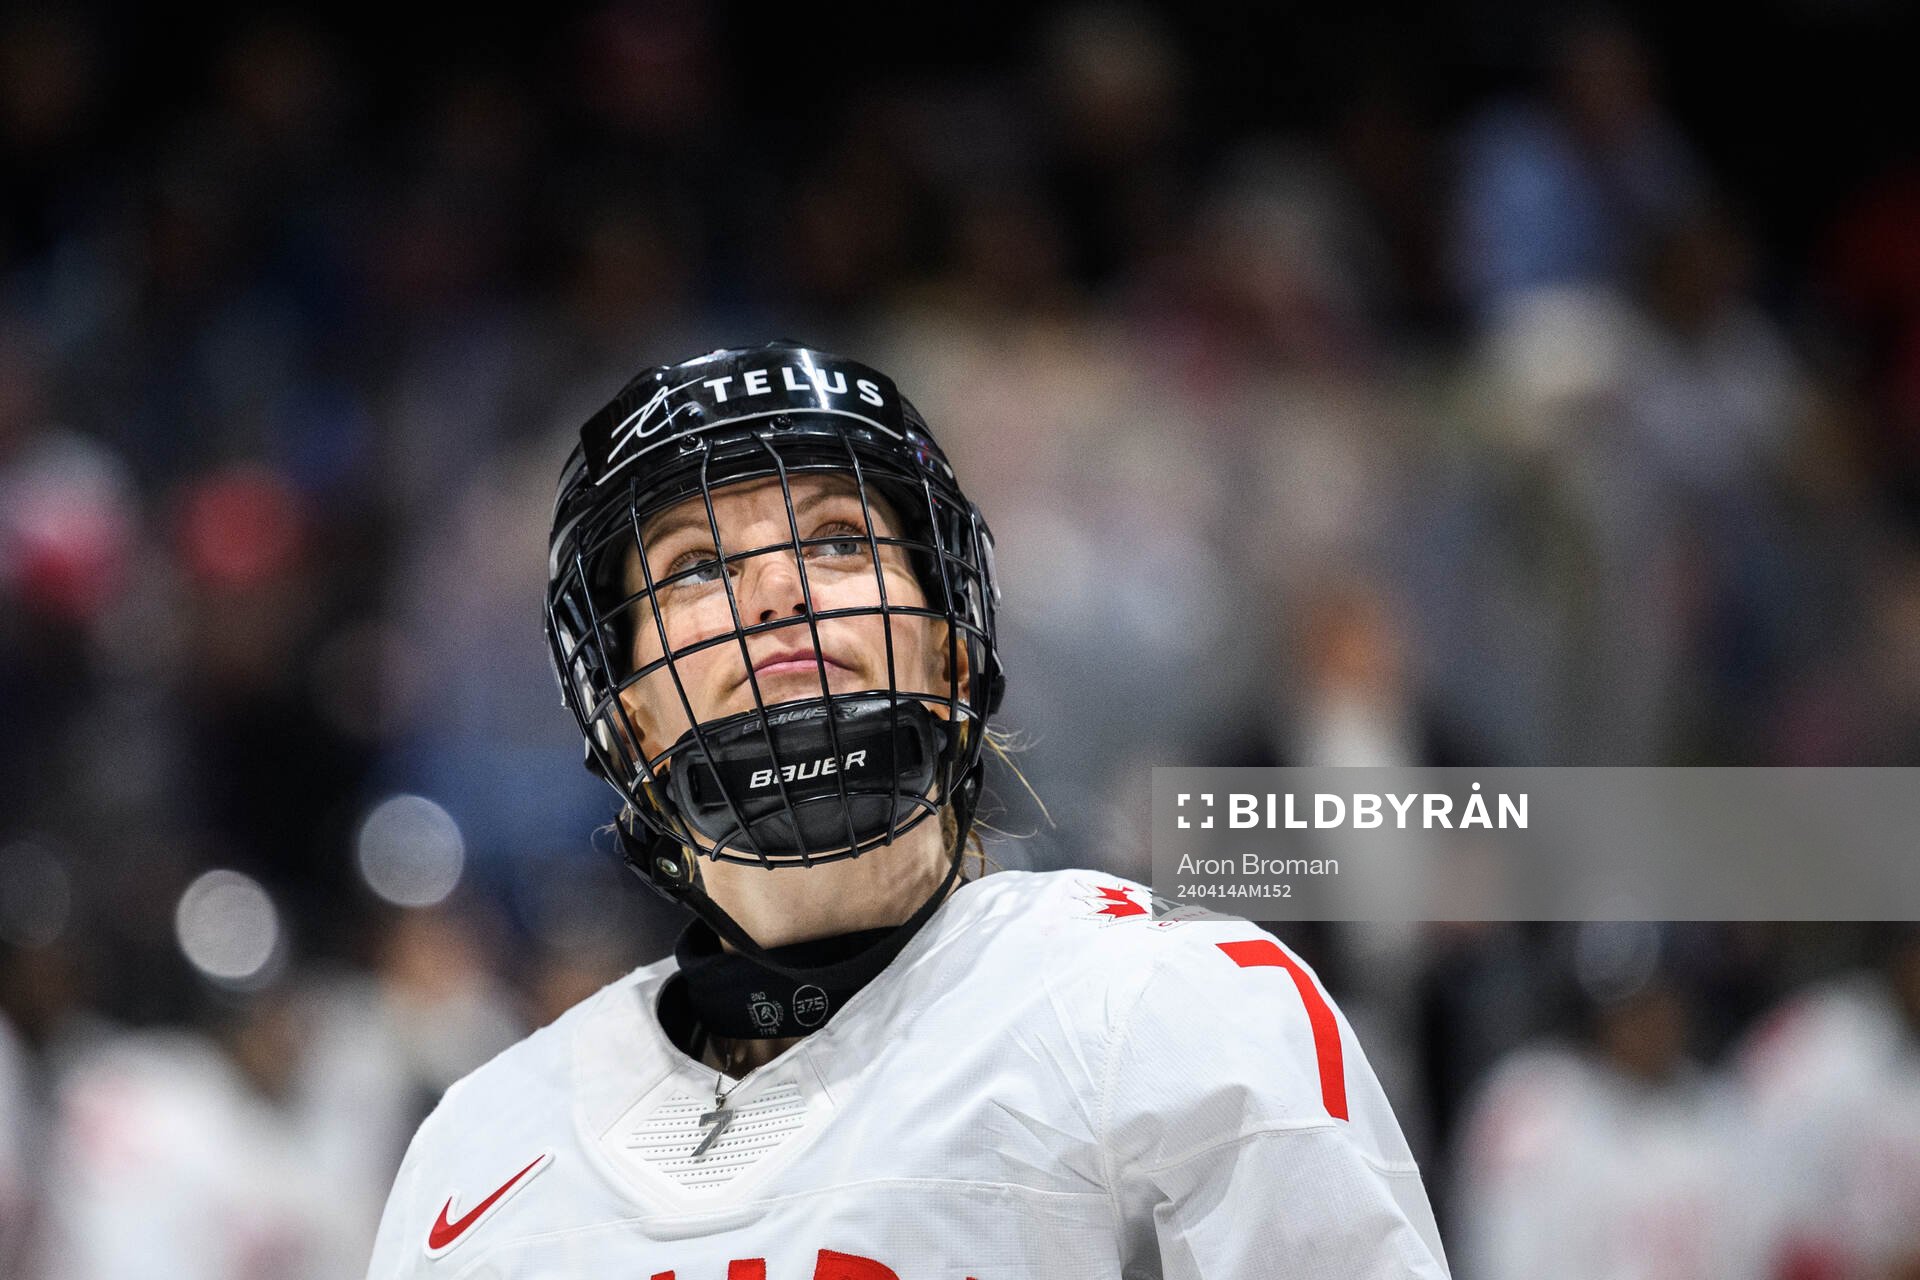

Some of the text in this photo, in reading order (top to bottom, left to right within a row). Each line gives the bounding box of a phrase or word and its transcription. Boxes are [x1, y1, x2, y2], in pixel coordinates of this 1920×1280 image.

[704, 368, 885, 407] TELUS
[749, 750, 866, 788] BAUER
[1215, 940, 1349, 1122] 7
[690, 1110, 735, 1157] 7
